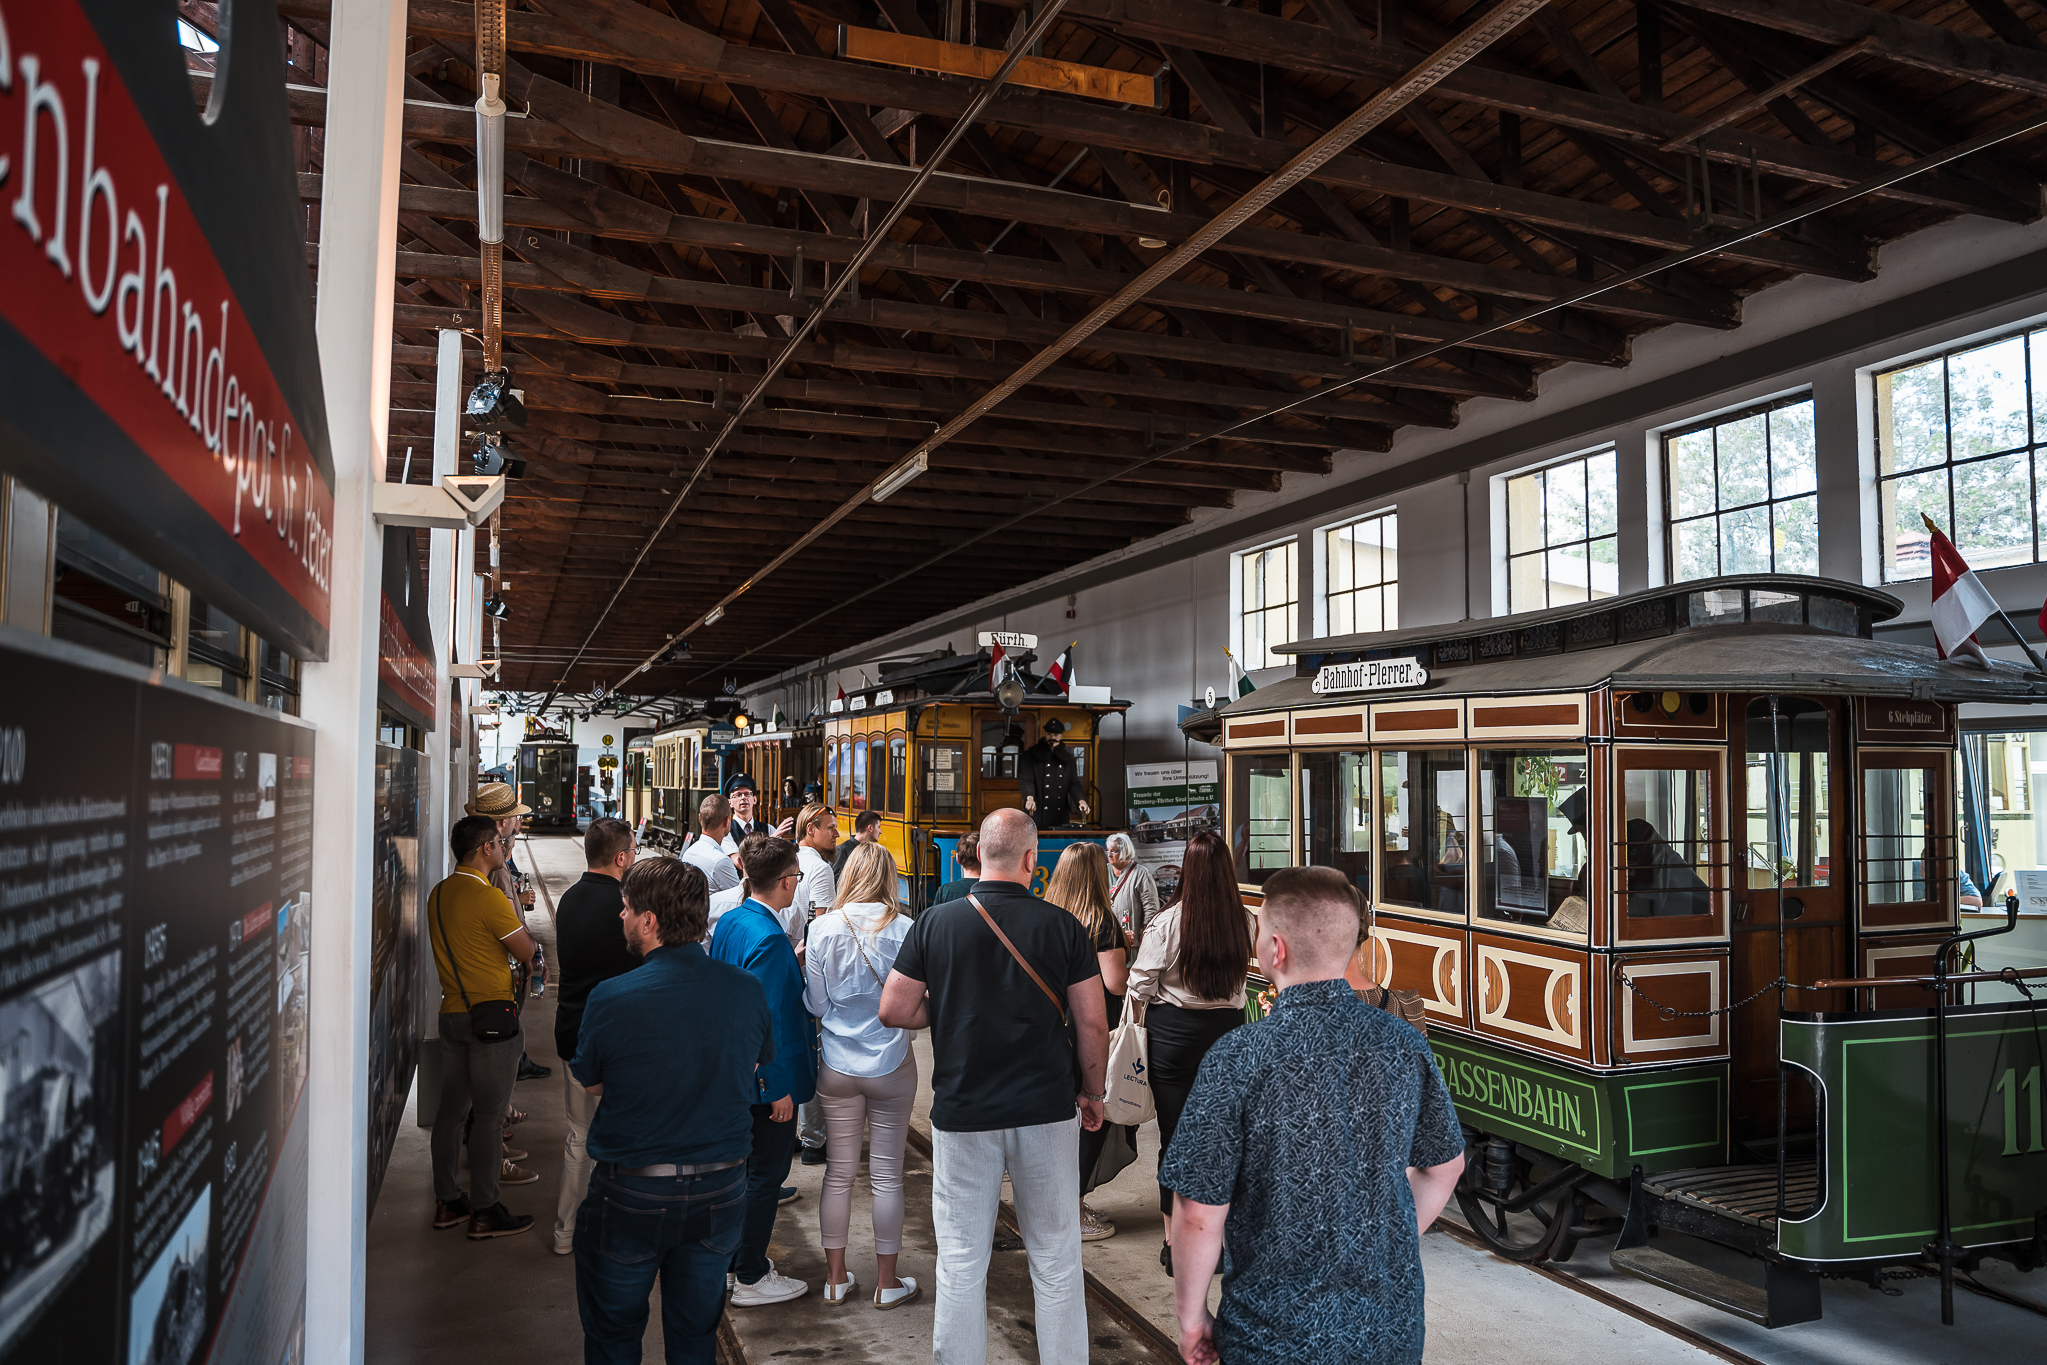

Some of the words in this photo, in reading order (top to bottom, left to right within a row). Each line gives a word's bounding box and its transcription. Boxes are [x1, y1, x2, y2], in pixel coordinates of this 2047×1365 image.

[0, 8, 275, 537] nbahndepot
[277, 422, 299, 556] St.
[302, 462, 333, 593] Peter
[991, 632, 1028, 647] Fürth.
[1322, 662, 1413, 690] Bahnhof-Plerrer.
[1888, 710, 1894, 722] 6
[1173, 773, 1209, 781] Untertützung!
[1124, 1074, 1147, 1086] LECTURA
[1996, 1065, 2046, 1156] 11
